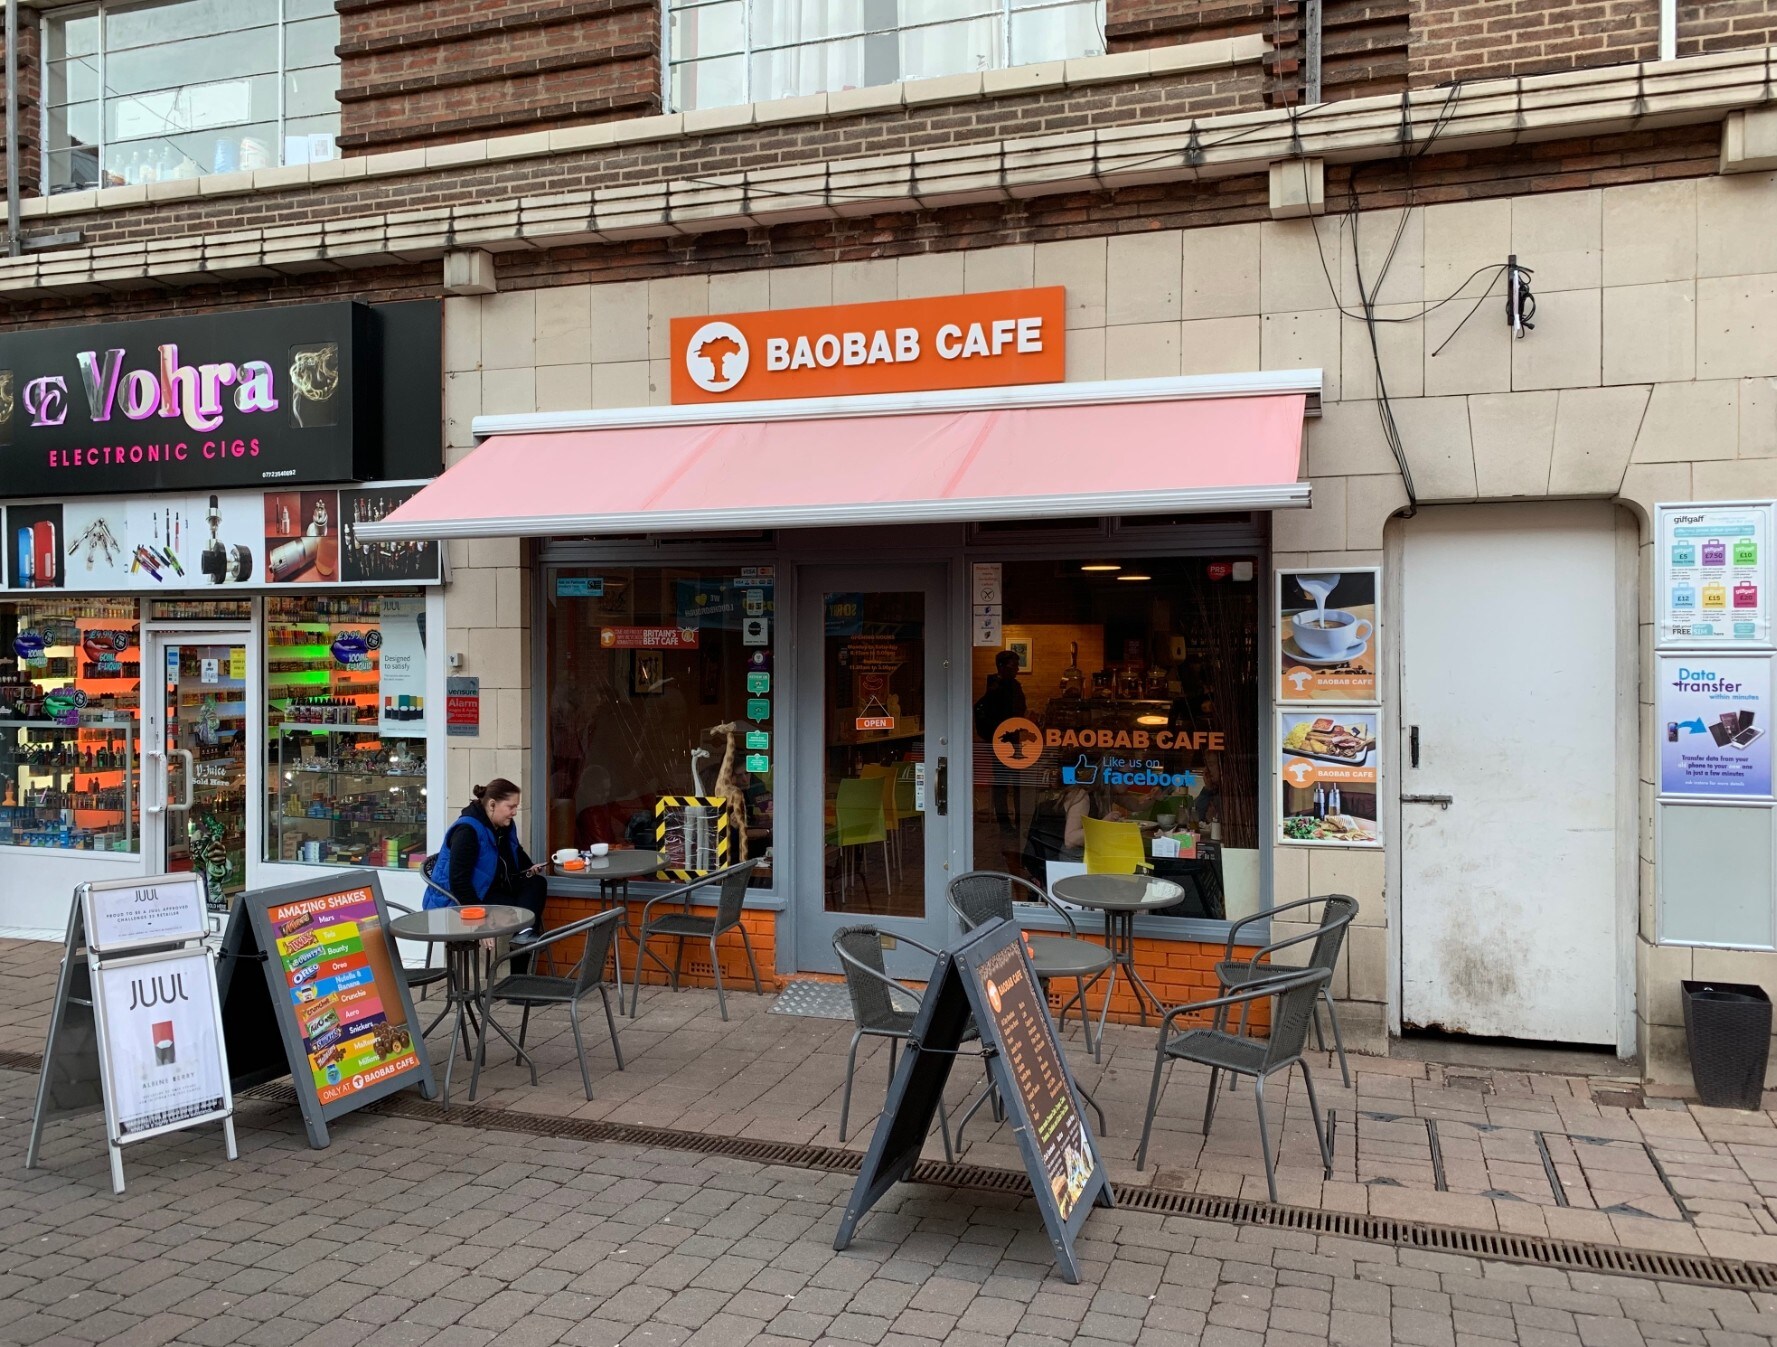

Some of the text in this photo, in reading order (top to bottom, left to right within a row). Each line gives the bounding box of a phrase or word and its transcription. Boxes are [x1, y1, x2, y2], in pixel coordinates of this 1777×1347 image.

[766, 317, 1042, 372] BAOBAB CAFE
[76, 343, 279, 432] Vohra
[49, 438, 260, 467] ELECTRONIC CIGS
[1674, 515, 1704, 524] giffgaff
[385, 655, 410, 664] Designed
[392, 663, 410, 671] satisfy
[1679, 668, 1715, 680] Data
[1678, 678, 1742, 692] transfer
[449, 699, 477, 707] Alarm
[1046, 729, 1225, 750] BAOBAB CAFE
[1103, 756, 1160, 769] Like us on
[1103, 769, 1197, 786] facebook
[1318, 770, 1373, 778] BAOBAB CAFE
[135, 888, 158, 902] JUUL
[278, 891, 366, 920] AMAZING SHAKES
[319, 915, 335, 923] Mars
[327, 945, 349, 954] Bounty
[332, 962, 347, 970] Oreo
[293, 964, 319, 984] OREO
[335, 973, 356, 983] Nutella
[338, 980, 360, 991] Banana
[998, 969, 1023, 996] BAOBAB CAFE
[130, 973, 189, 1010] JUUL
[341, 990, 366, 1002] Crunchie
[346, 1009, 360, 1018] Aero
[349, 1021, 374, 1034] Snickers
[354, 1037, 381, 1050] Maltesers
[173, 1072, 195, 1082] BERRY
[323, 1056, 414, 1099] ONLY AT BAOBAB CAFE
